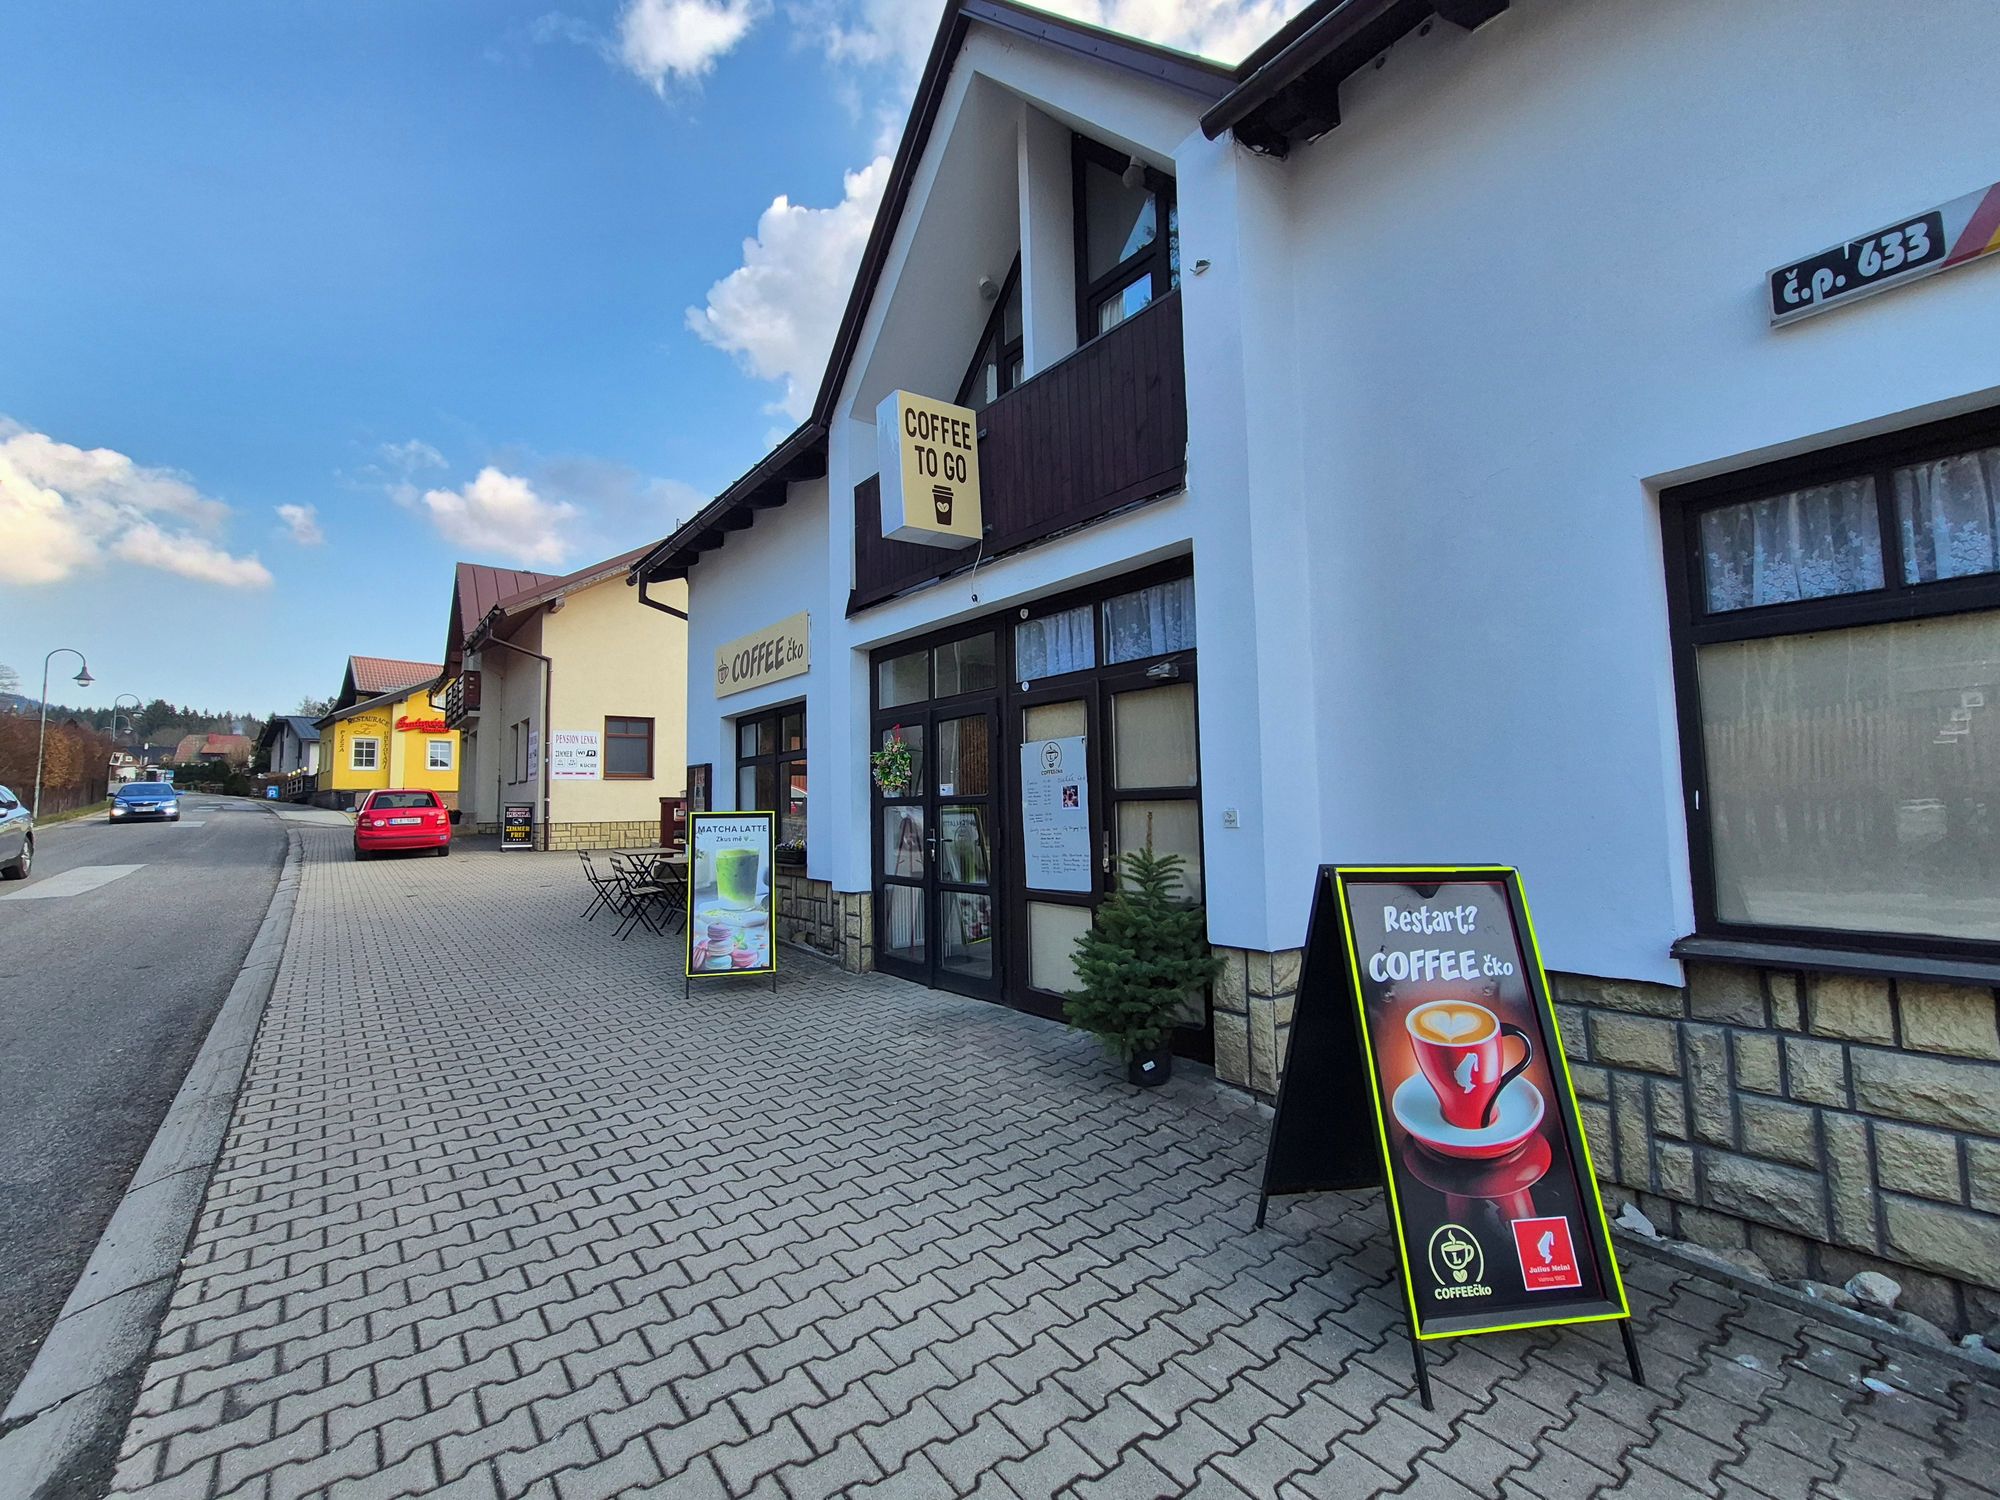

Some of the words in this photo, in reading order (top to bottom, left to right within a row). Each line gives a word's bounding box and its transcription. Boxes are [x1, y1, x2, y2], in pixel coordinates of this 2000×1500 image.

[1783, 268, 1847, 304] č.p.
[1857, 222, 1931, 277] 633
[905, 407, 972, 451] COFFEE
[914, 445, 938, 477] TO
[943, 451, 967, 483] GO
[731, 635, 785, 682] COFFEE
[786, 637, 804, 662] čko
[347, 715, 391, 727] RESTAURACE
[555, 734, 579, 744] PENSION
[580, 735, 598, 745] LENKA
[697, 825, 738, 833] MATCHA
[740, 824, 767, 833] LATTE
[1383, 905, 1478, 935] Restart?
[1369, 949, 1481, 983] COFFEE
[1483, 953, 1514, 976] čko
[1451, 1251, 1462, 1265] L
[1528, 1265, 1551, 1274] Julius
[1551, 1264, 1571, 1272] Meinl
[1434, 1284, 1493, 1300] COFFEEčko
